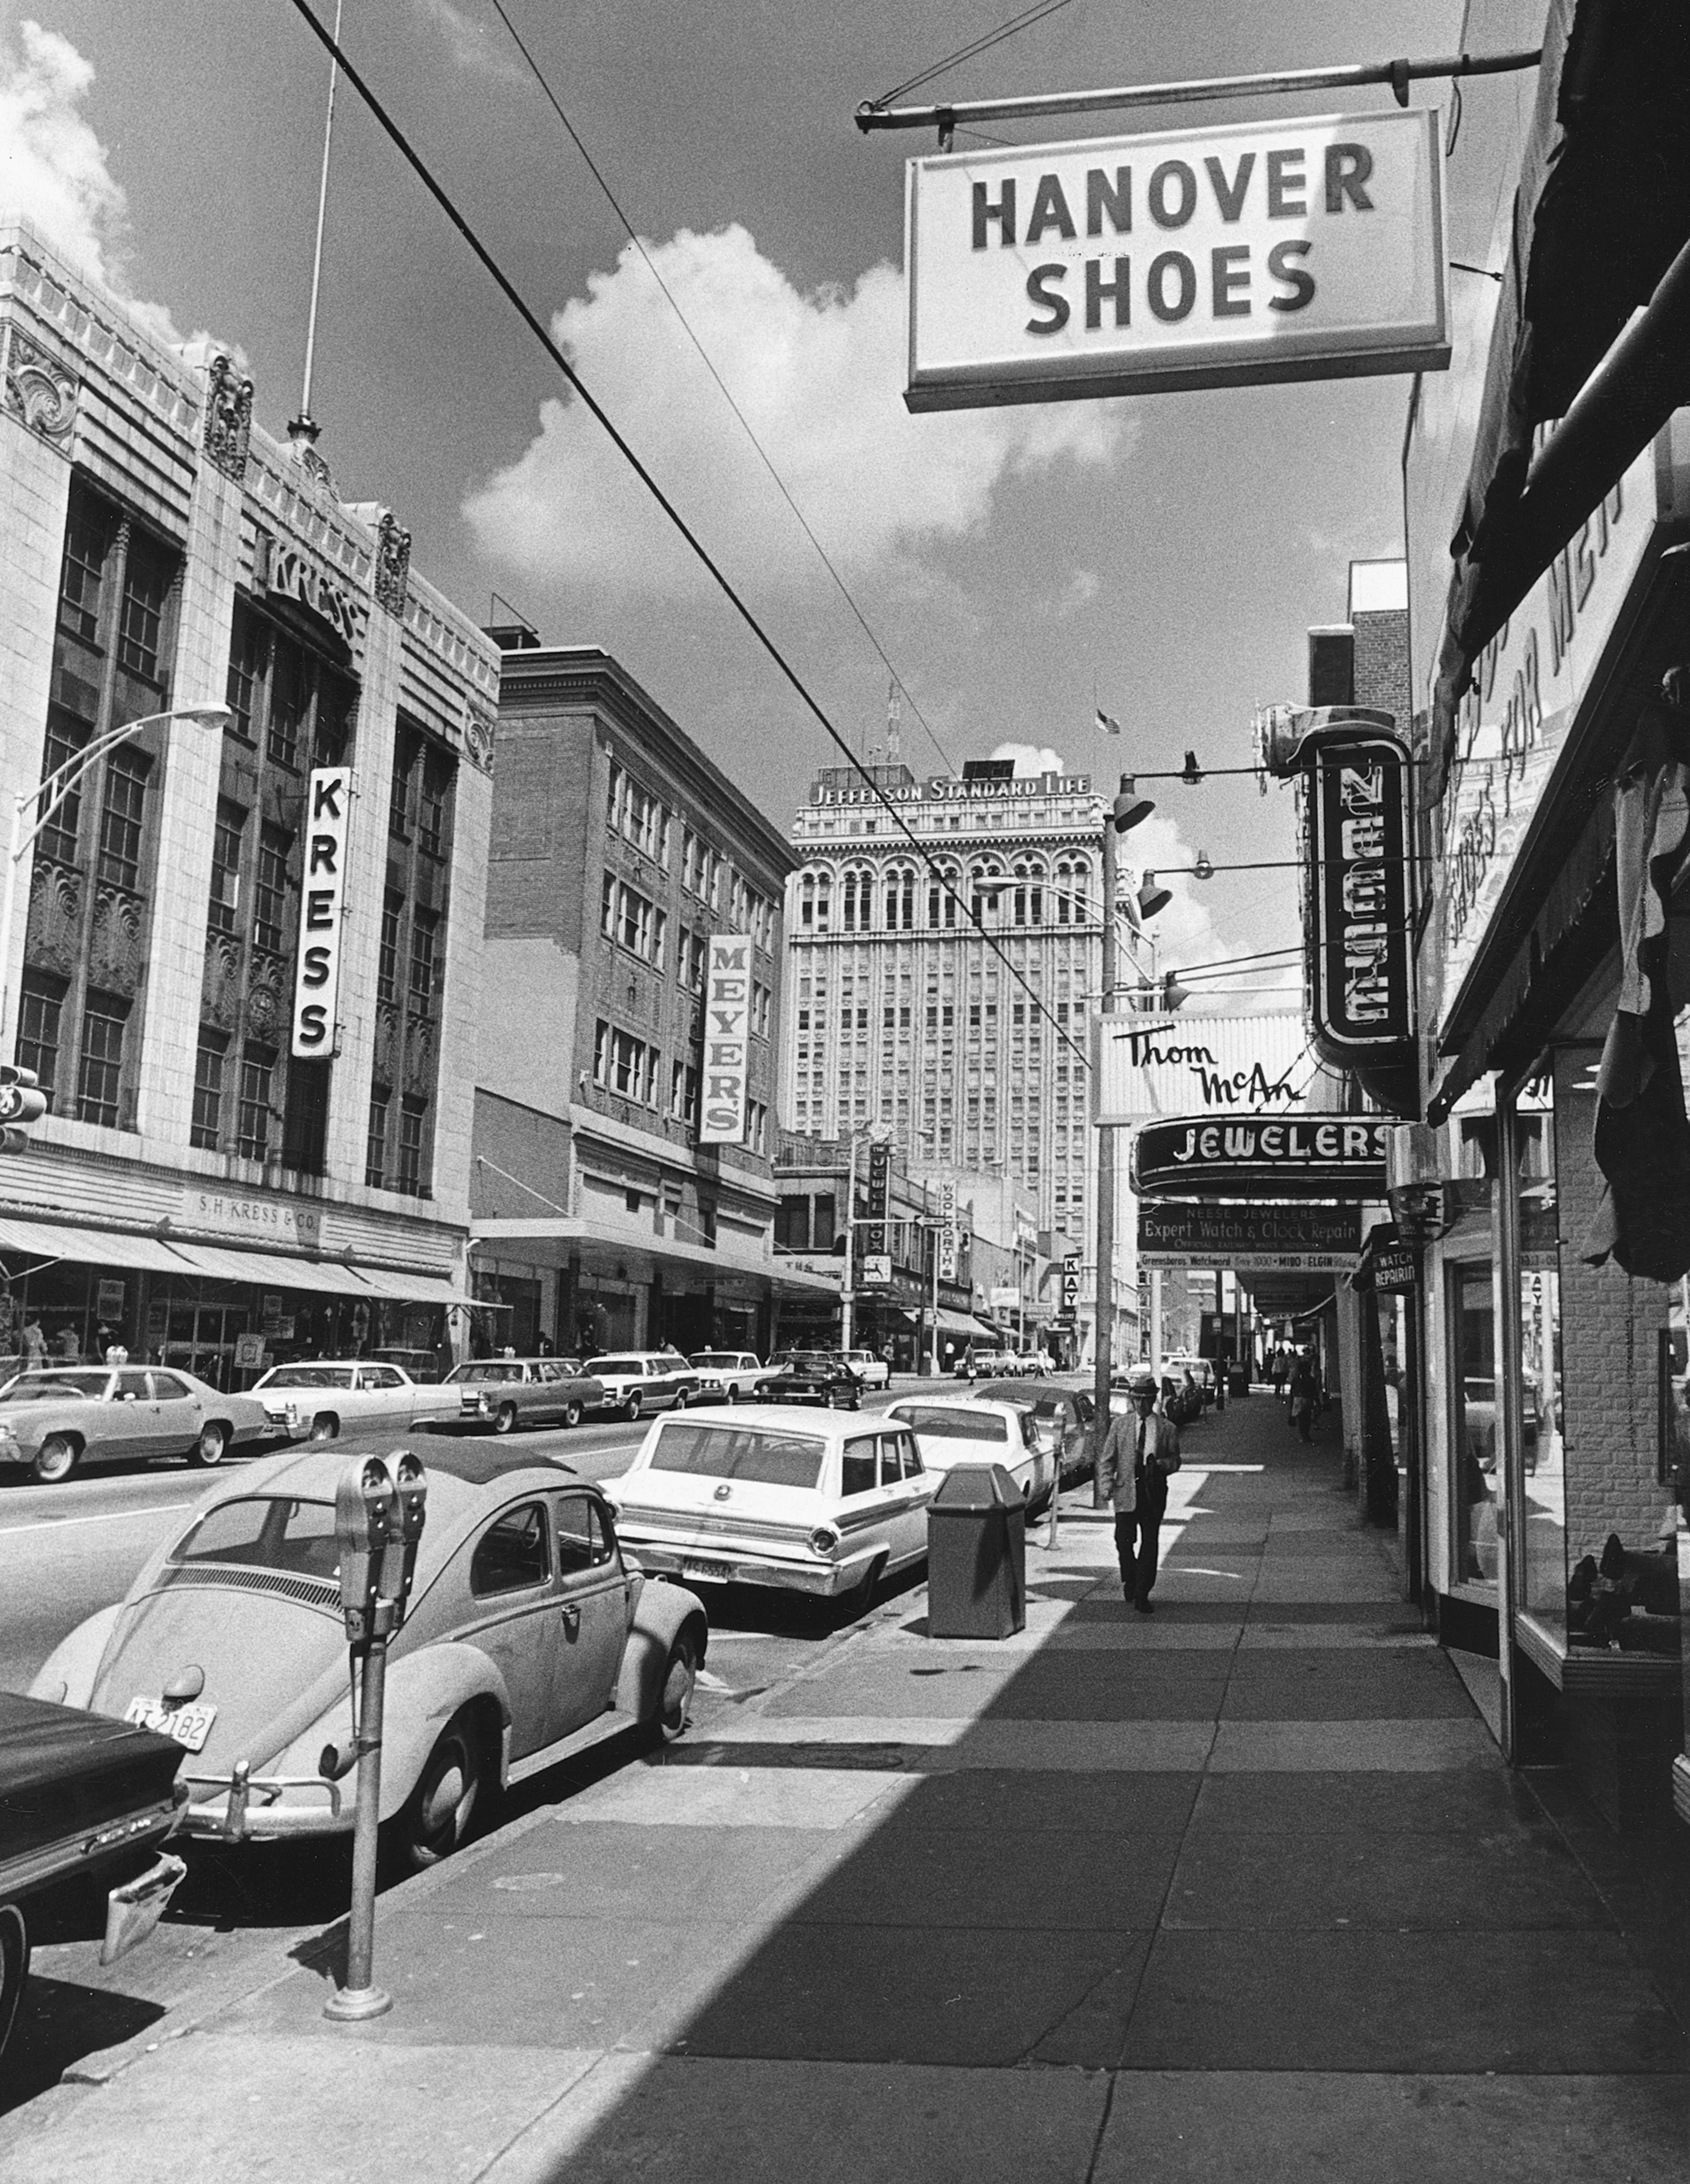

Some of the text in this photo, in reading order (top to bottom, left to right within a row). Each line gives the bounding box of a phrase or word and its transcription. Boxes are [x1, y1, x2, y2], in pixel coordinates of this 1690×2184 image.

[972, 142, 1374, 251] HANOVER
[1025, 239, 1316, 335] SHOES
[271, 543, 360, 651] KRESS
[811, 774, 1088, 806] JEFFERSON STANDARD LIFE
[299, 779, 342, 1045] KRESS
[1340, 766, 1389, 1021] NEESE
[705, 947, 747, 1131] MEYER'S
[1113, 1024, 1218, 1067] Thom
[1190, 1062, 1307, 1104] McAn
[1173, 1125, 1387, 1161] JEWELERS
[231, 1201, 277, 1224] KRESS
[284, 1211, 292, 1225] &
[298, 1214, 316, 1229] CO.
[1145, 1220, 1356, 1243] Expert Watch & Clock Repair
[1187, 1208, 1316, 1220] NEESE JEWELERS
[1308, 1256, 1333, 1267] ELGIN
[1378, 1251, 1413, 1268] WATCH
[1067, 1260, 1077, 1304] KAY
